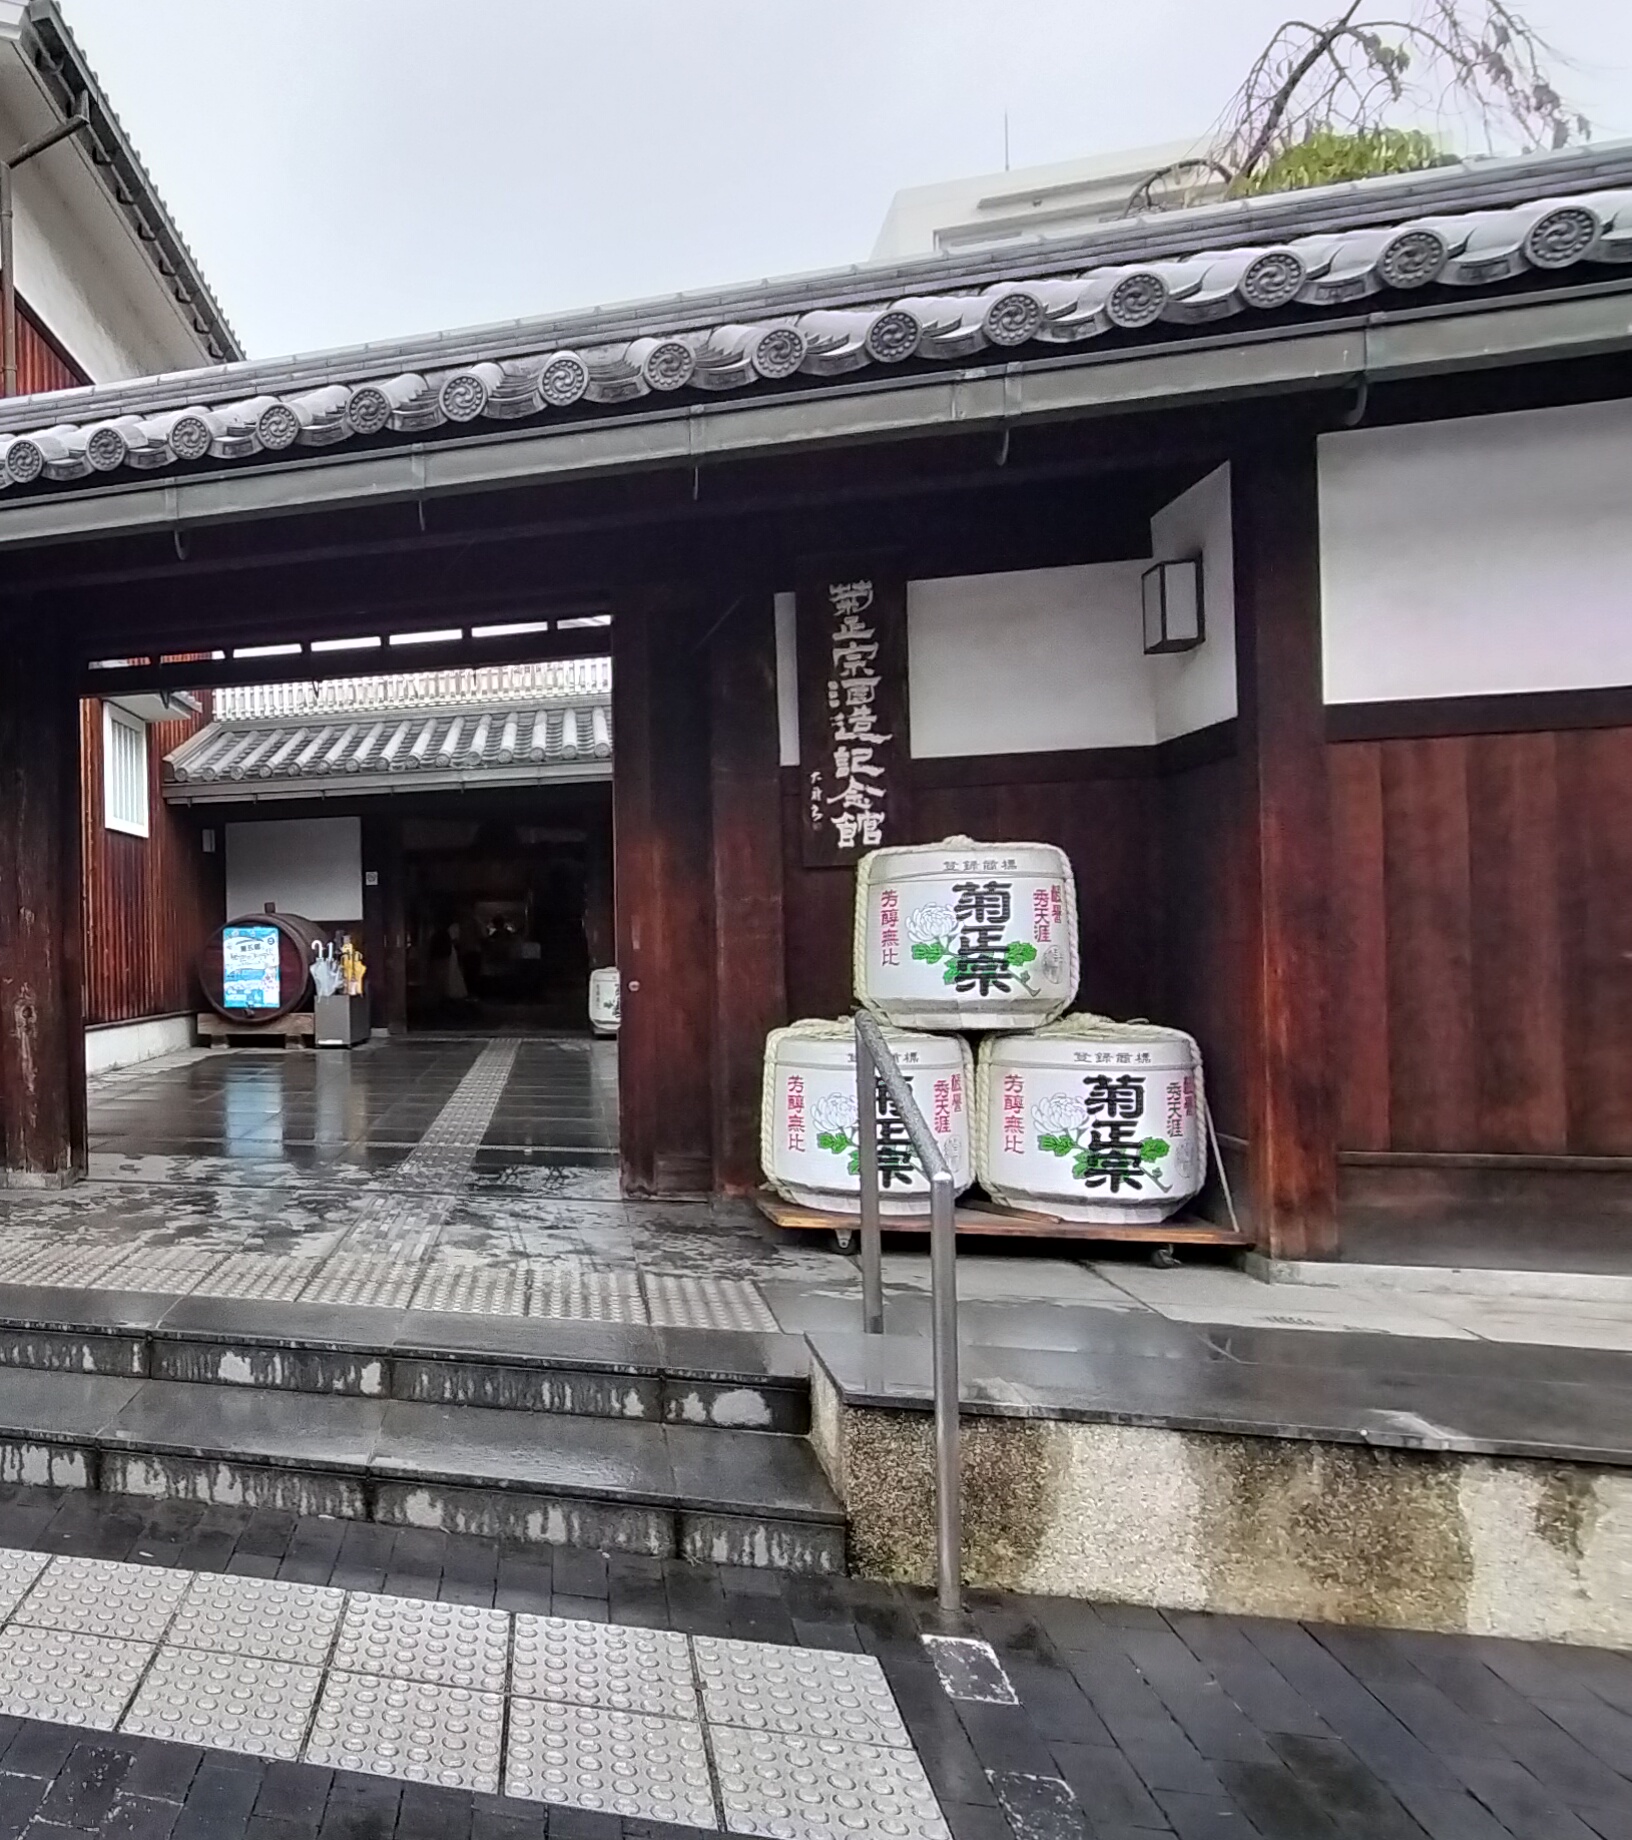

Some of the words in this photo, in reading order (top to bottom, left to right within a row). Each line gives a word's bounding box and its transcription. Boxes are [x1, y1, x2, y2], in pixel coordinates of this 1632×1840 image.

[881, 889, 899, 966] 芳醇無比
[952, 881, 1014, 996] 菊正宗
[788, 1075, 805, 1152] 芳醇無比
[1004, 1074, 1024, 1154] 芳醇無比
[1083, 1074, 1146, 1193] 菊正宗
